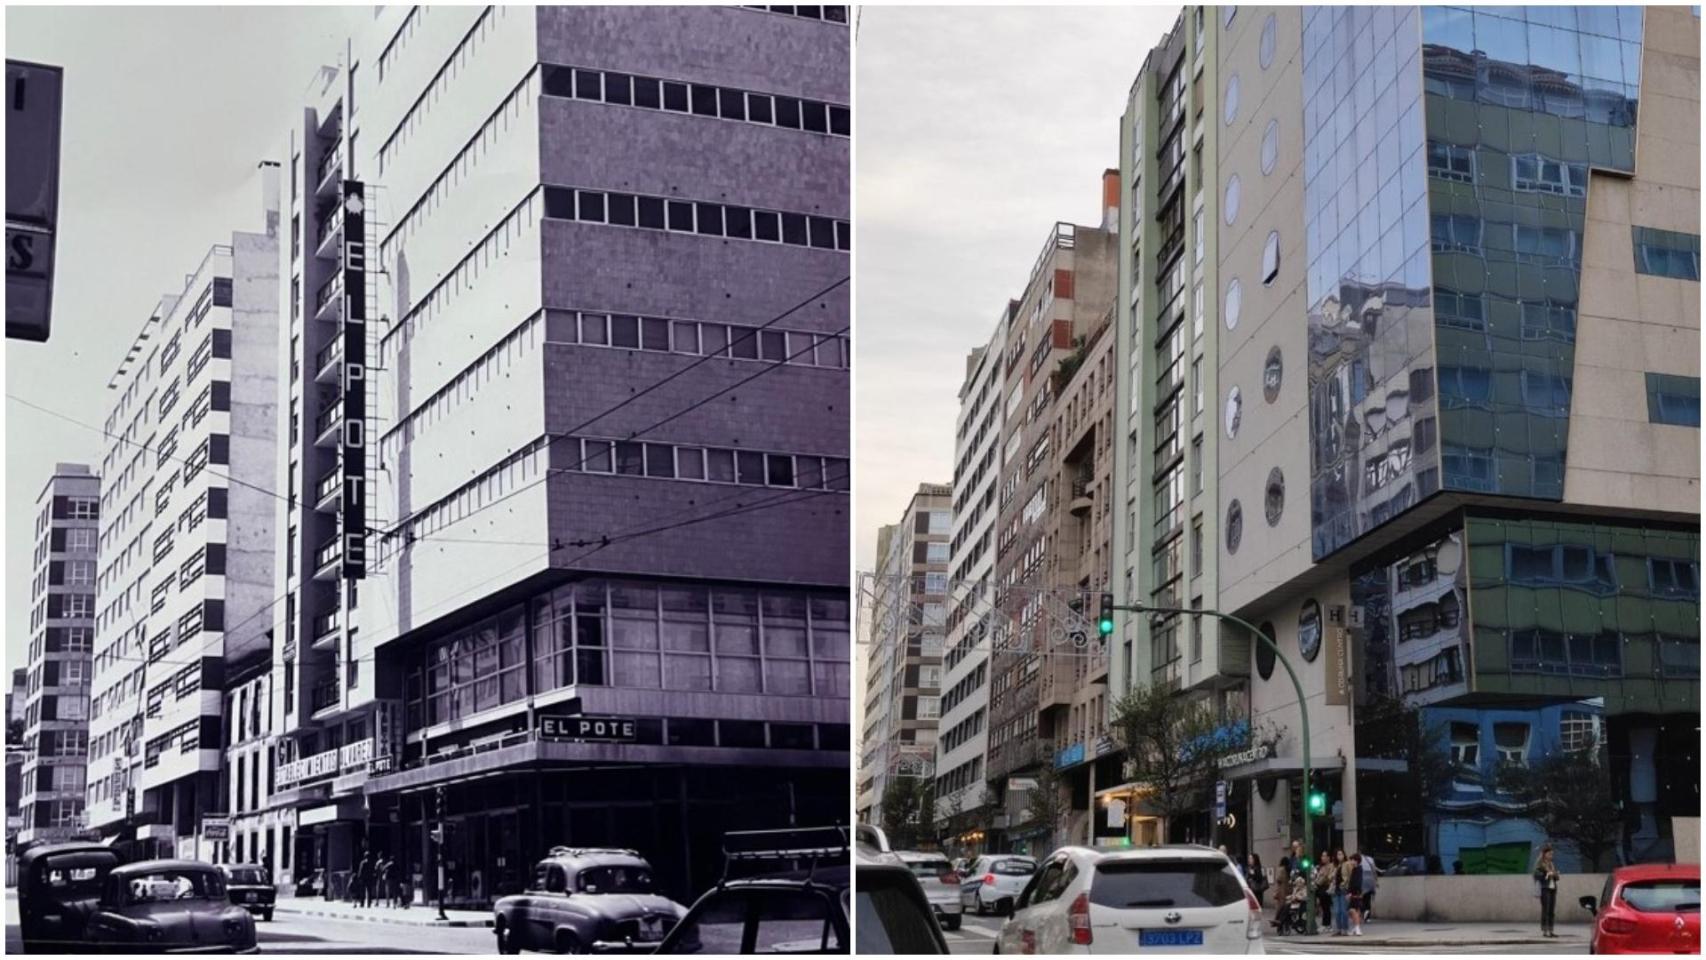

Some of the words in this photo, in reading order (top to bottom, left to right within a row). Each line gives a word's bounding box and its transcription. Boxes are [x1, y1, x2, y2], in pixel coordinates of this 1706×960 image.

[346, 241, 364, 324] EL
[345, 363, 364, 564] POTE
[543, 720, 568, 734] EL
[580, 721, 633, 736] POTE
